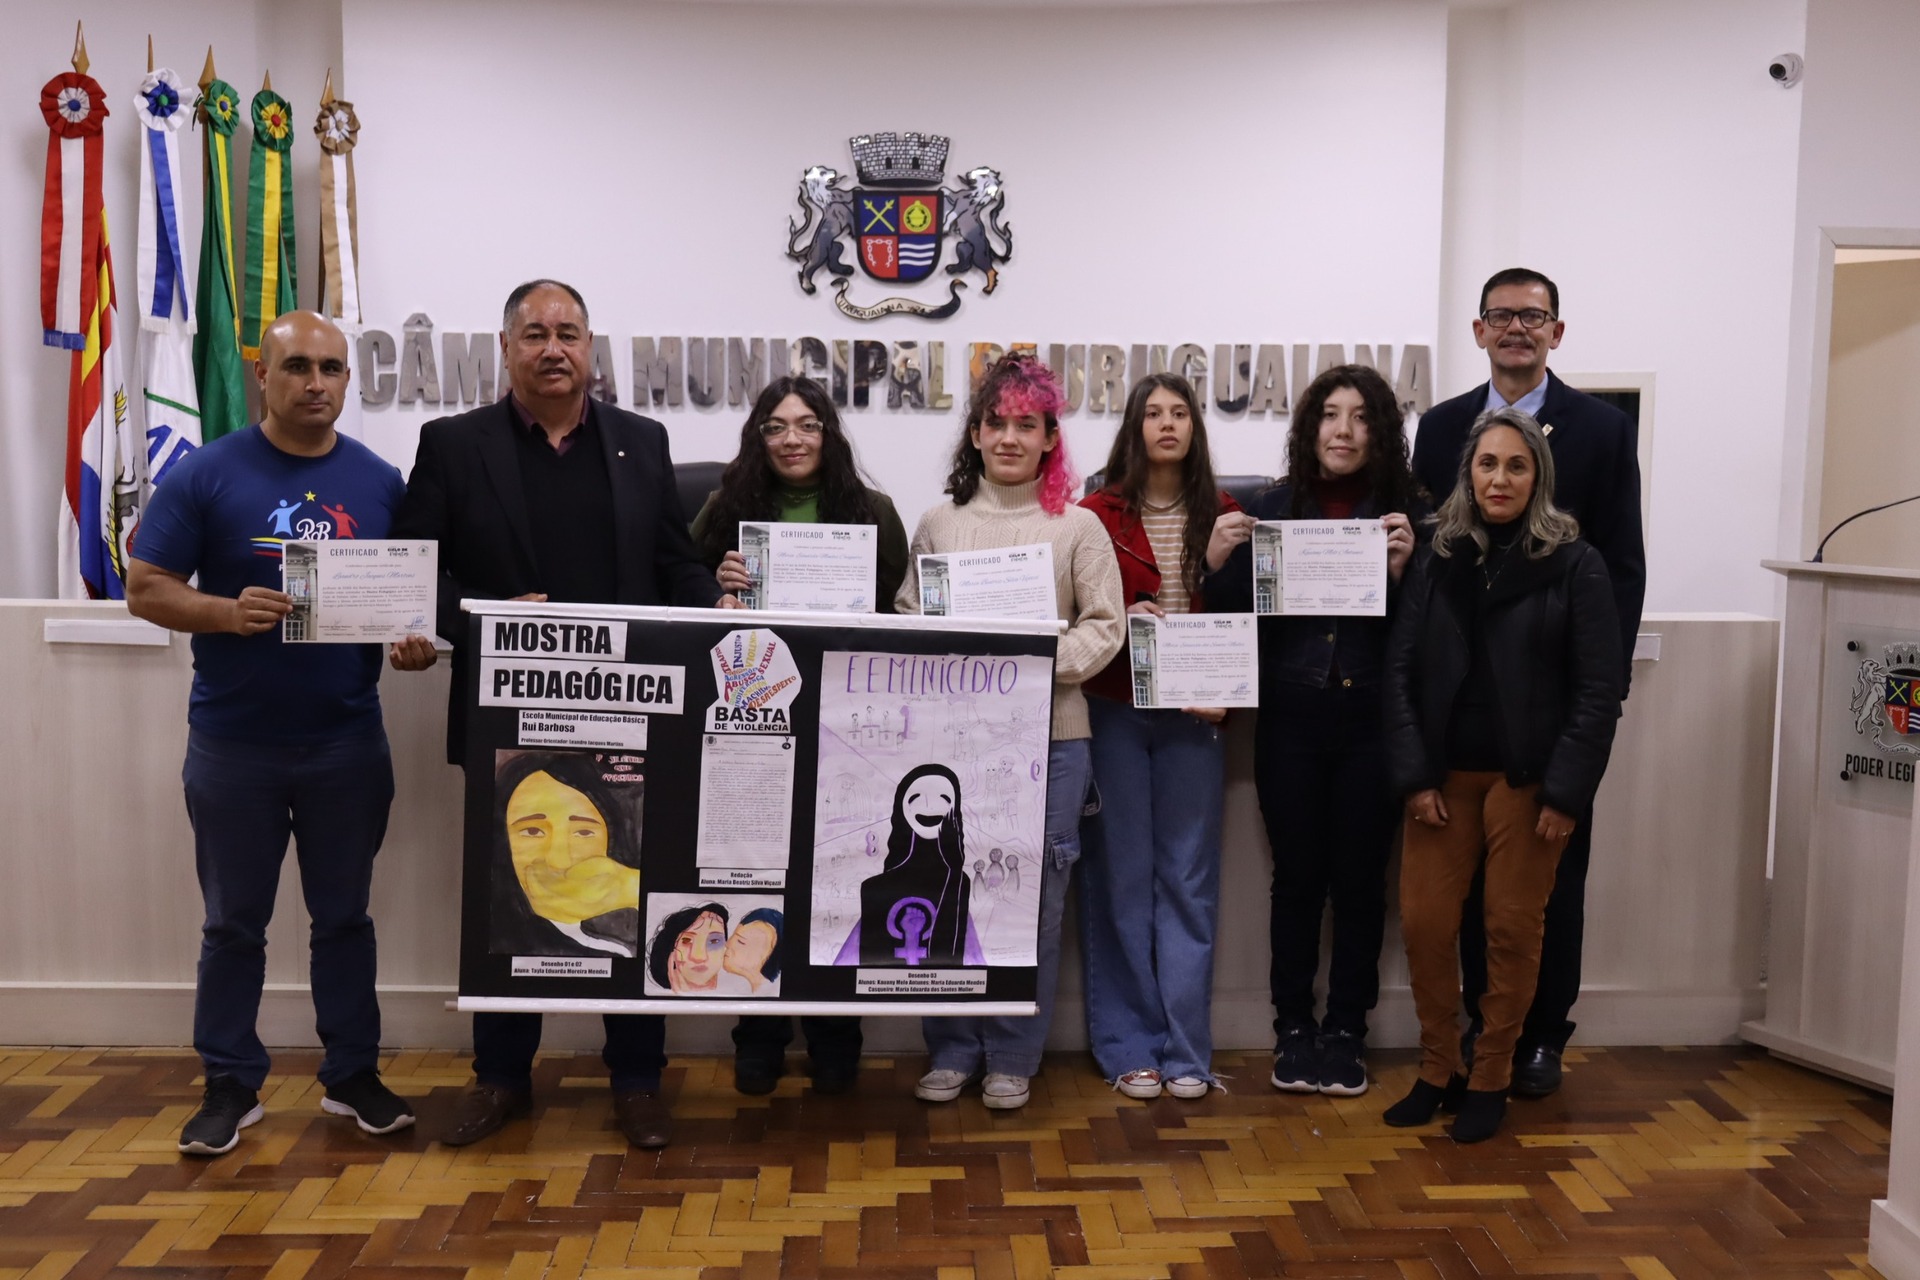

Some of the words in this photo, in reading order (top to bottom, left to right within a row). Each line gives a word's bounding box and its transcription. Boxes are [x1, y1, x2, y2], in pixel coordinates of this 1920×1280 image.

[357, 313, 618, 404] CÂMA
[780, 530, 824, 539] CERTIFICADO
[1292, 527, 1335, 536] CERTIFICADO
[330, 548, 379, 557] CERTIFICADO
[959, 556, 1002, 567] CERTIFICADO
[1165, 621, 1206, 629] CERTIFICADO
[494, 621, 612, 655] MOSTRA
[758, 641, 777, 674] SEXUAL
[493, 667, 674, 704] PEDAGÓGICA
[748, 675, 797, 709] DESRESPEITO
[522, 711, 544, 720] Escola
[545, 712, 579, 721] Municipal
[579, 713, 588, 721] de
[589, 714, 622, 724] Educação
[623, 715, 646, 724] Básica
[715, 706, 787, 723] BASTA
[522, 722, 536, 731] Rui
[538, 722, 575, 733] Barbosa
[714, 722, 728, 731] DE
[734, 723, 789, 732] VIOLÊNCIA
[1845, 753, 1884, 778] PODER
